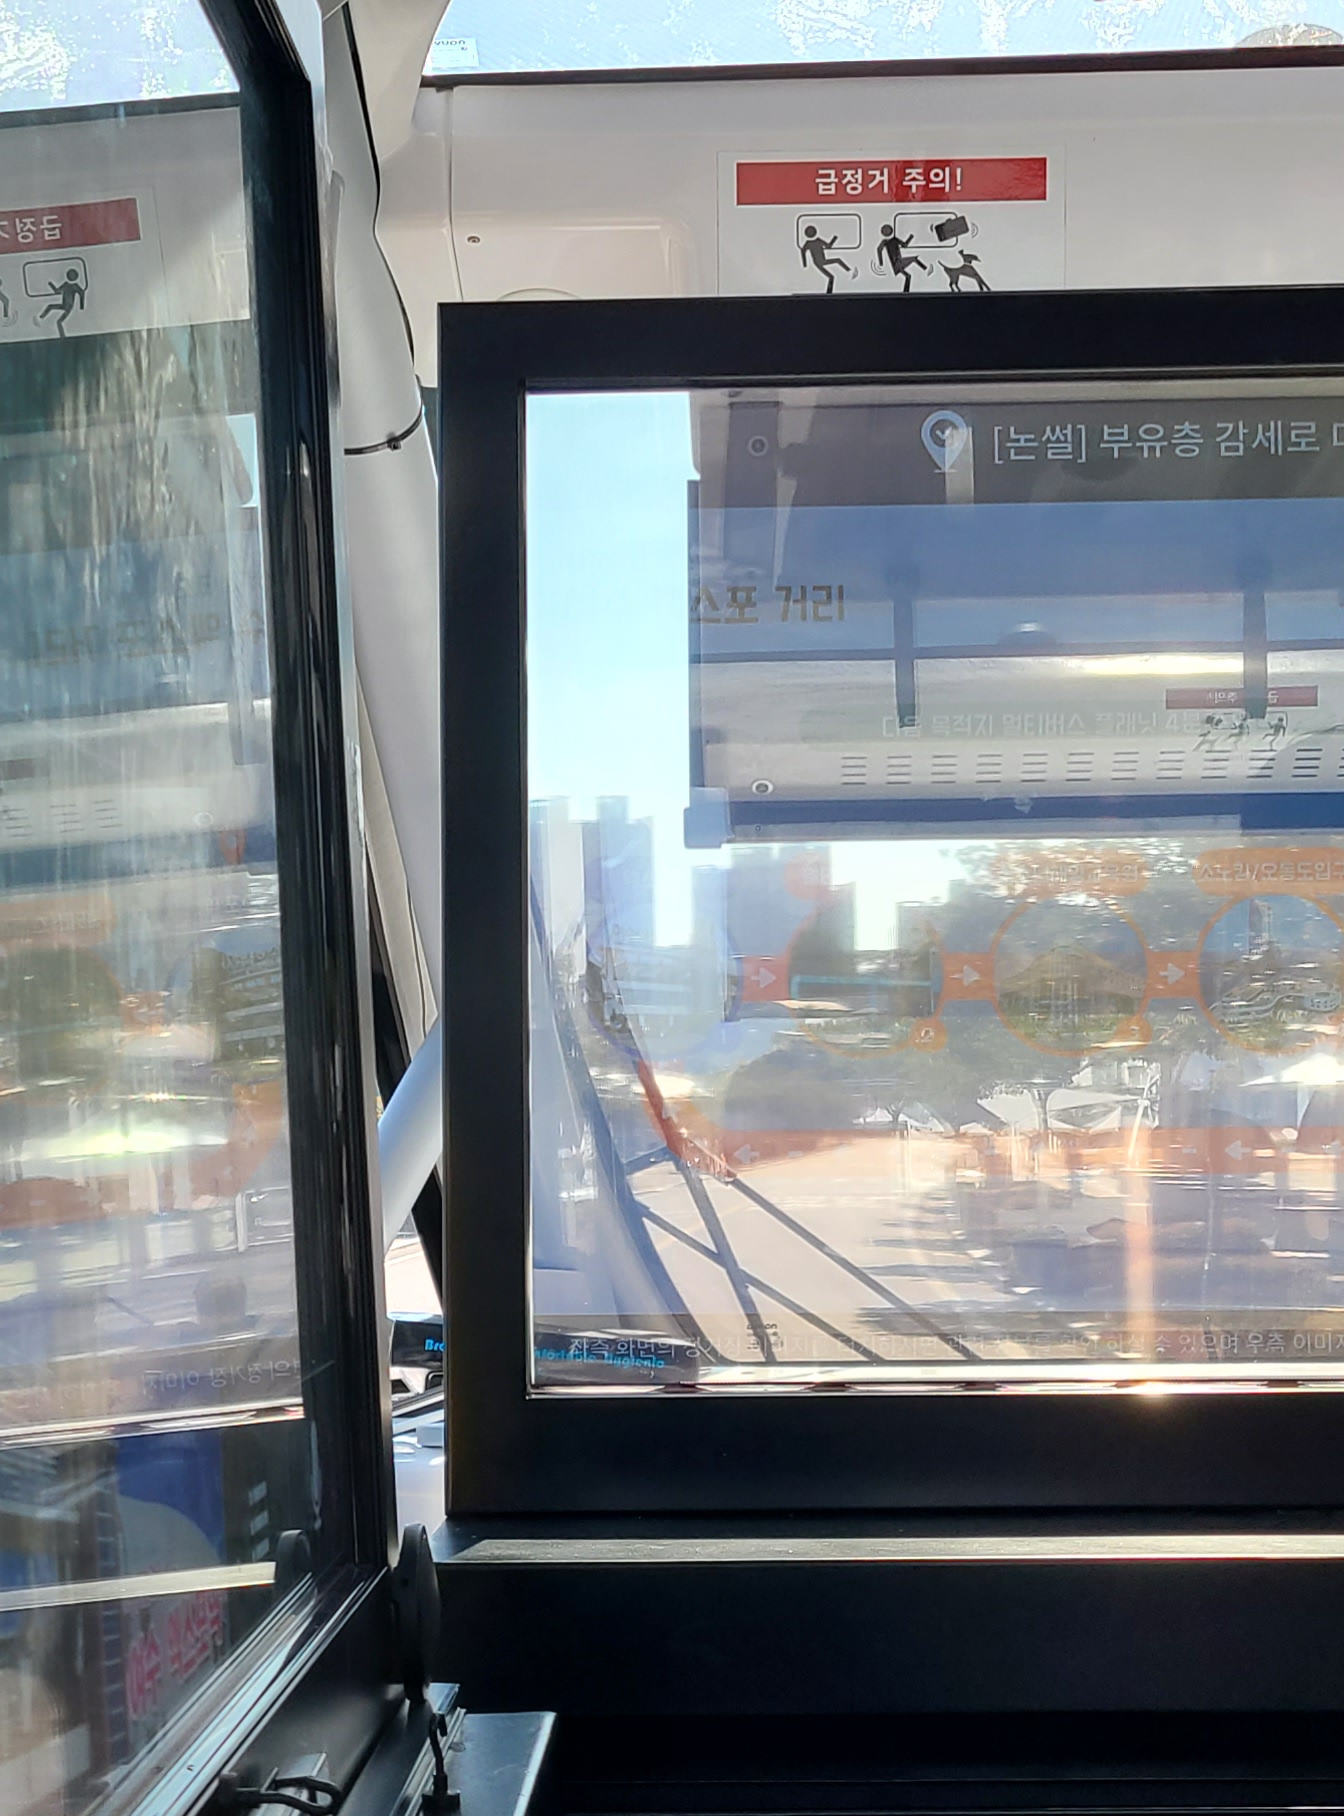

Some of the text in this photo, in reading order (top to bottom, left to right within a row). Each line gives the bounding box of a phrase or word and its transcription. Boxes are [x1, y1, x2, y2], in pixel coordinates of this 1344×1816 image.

[816, 166, 962, 196] 급정거 주의!
[993, 424, 1086, 465] [논썰]
[1098, 421, 1204, 459] 부유층
[1214, 419, 1321, 458] 감세로
[774, 583, 845, 623] 거리
[932, 713, 994, 737] 목적지
[1002, 711, 1085, 737] 멀티버스
[568, 1337, 610, 1362] 좌측
[616, 1337, 675, 1361] 화면의
